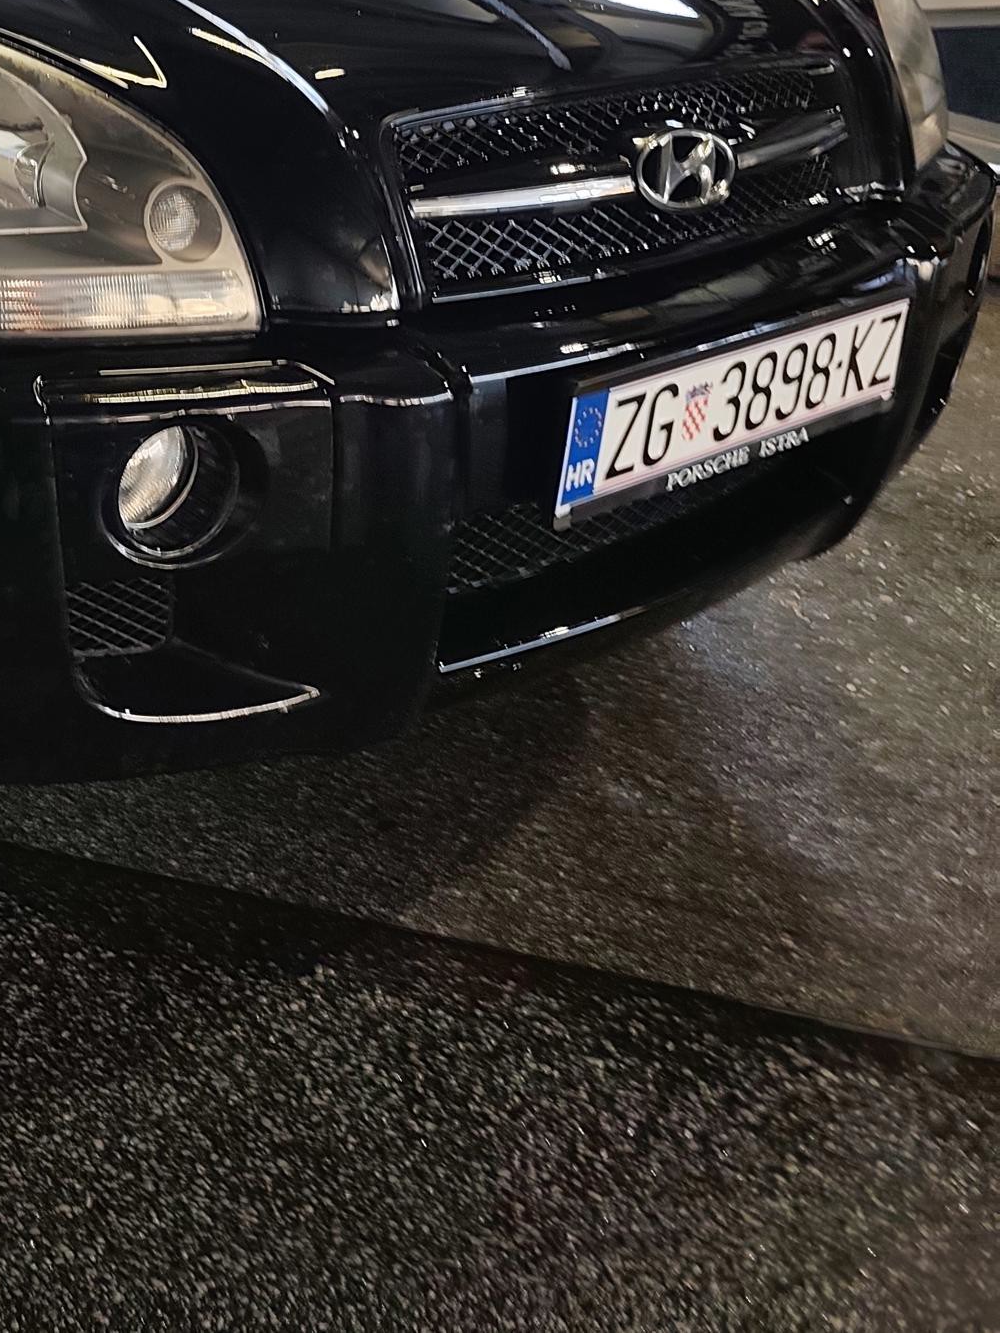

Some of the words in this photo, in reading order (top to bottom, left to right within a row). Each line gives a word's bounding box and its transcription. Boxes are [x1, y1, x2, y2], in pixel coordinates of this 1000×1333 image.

[605, 383, 680, 480] ZG
[665, 446, 750, 492] PORSCHE
[758, 427, 810, 458] ISTRA
[565, 459, 596, 492] HR
